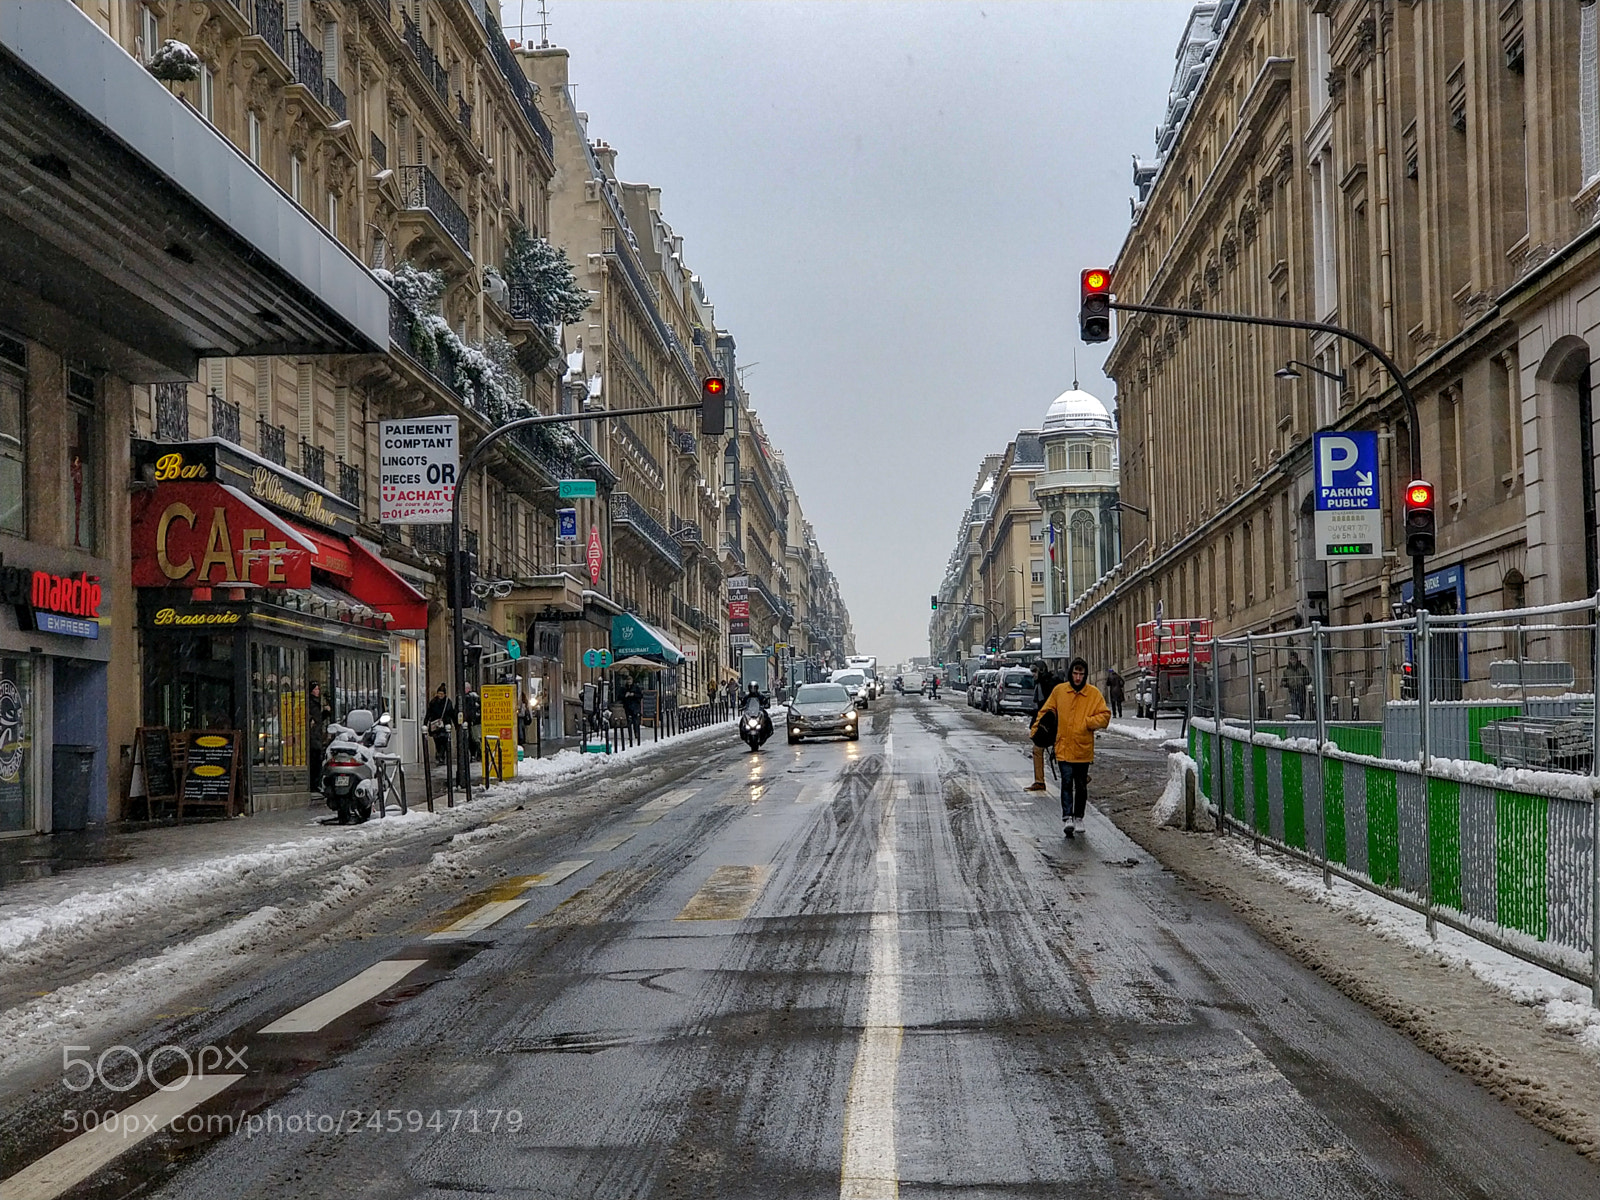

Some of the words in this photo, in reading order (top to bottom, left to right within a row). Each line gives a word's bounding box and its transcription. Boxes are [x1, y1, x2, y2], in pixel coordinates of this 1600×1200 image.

[385, 425, 452, 435] PAIEMENT
[385, 439, 453, 449] COMPTANT
[382, 456, 428, 466] LINGOTS
[1320, 436, 1359, 487] P
[155, 453, 209, 481] Bar
[382, 474, 421, 484] PIECES
[426, 463, 455, 484] OR
[397, 490, 443, 501] ACHAT
[1321, 487, 1373, 498] PARKING
[1327, 498, 1369, 508] PUBLIC
[1327, 524, 1356, 532] OUVERT
[156, 501, 289, 584] CAFE
[588, 532, 601, 576] TABAC
[1333, 545, 1360, 553] LIBRE
[154, 608, 240, 626] Brasserie
[47, 617, 90, 635] EXPRESS
